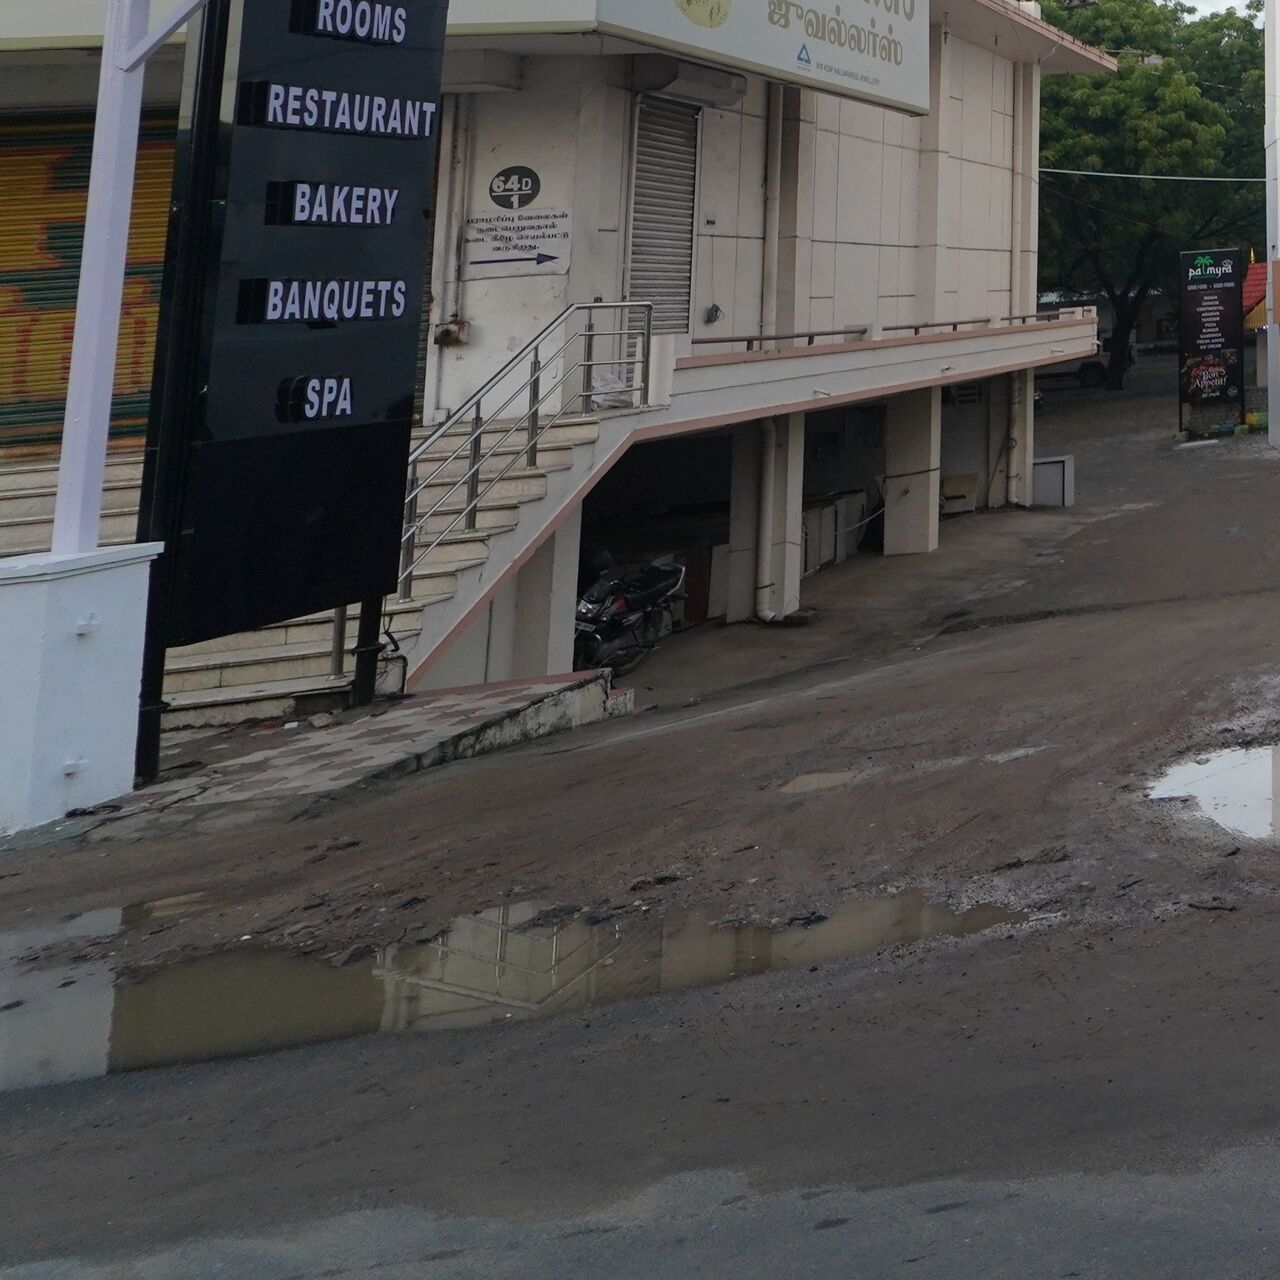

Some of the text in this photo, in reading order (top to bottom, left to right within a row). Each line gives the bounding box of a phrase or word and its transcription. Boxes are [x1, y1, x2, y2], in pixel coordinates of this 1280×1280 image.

[267, 83, 436, 137] RESTAURANT
[294, 183, 399, 225] BAKERY
[511, 195, 519, 209] 1
[1188, 260, 1232, 280] palmyra
[266, 280, 406, 321] BANQUETS
[304, 377, 352, 418] SPA
